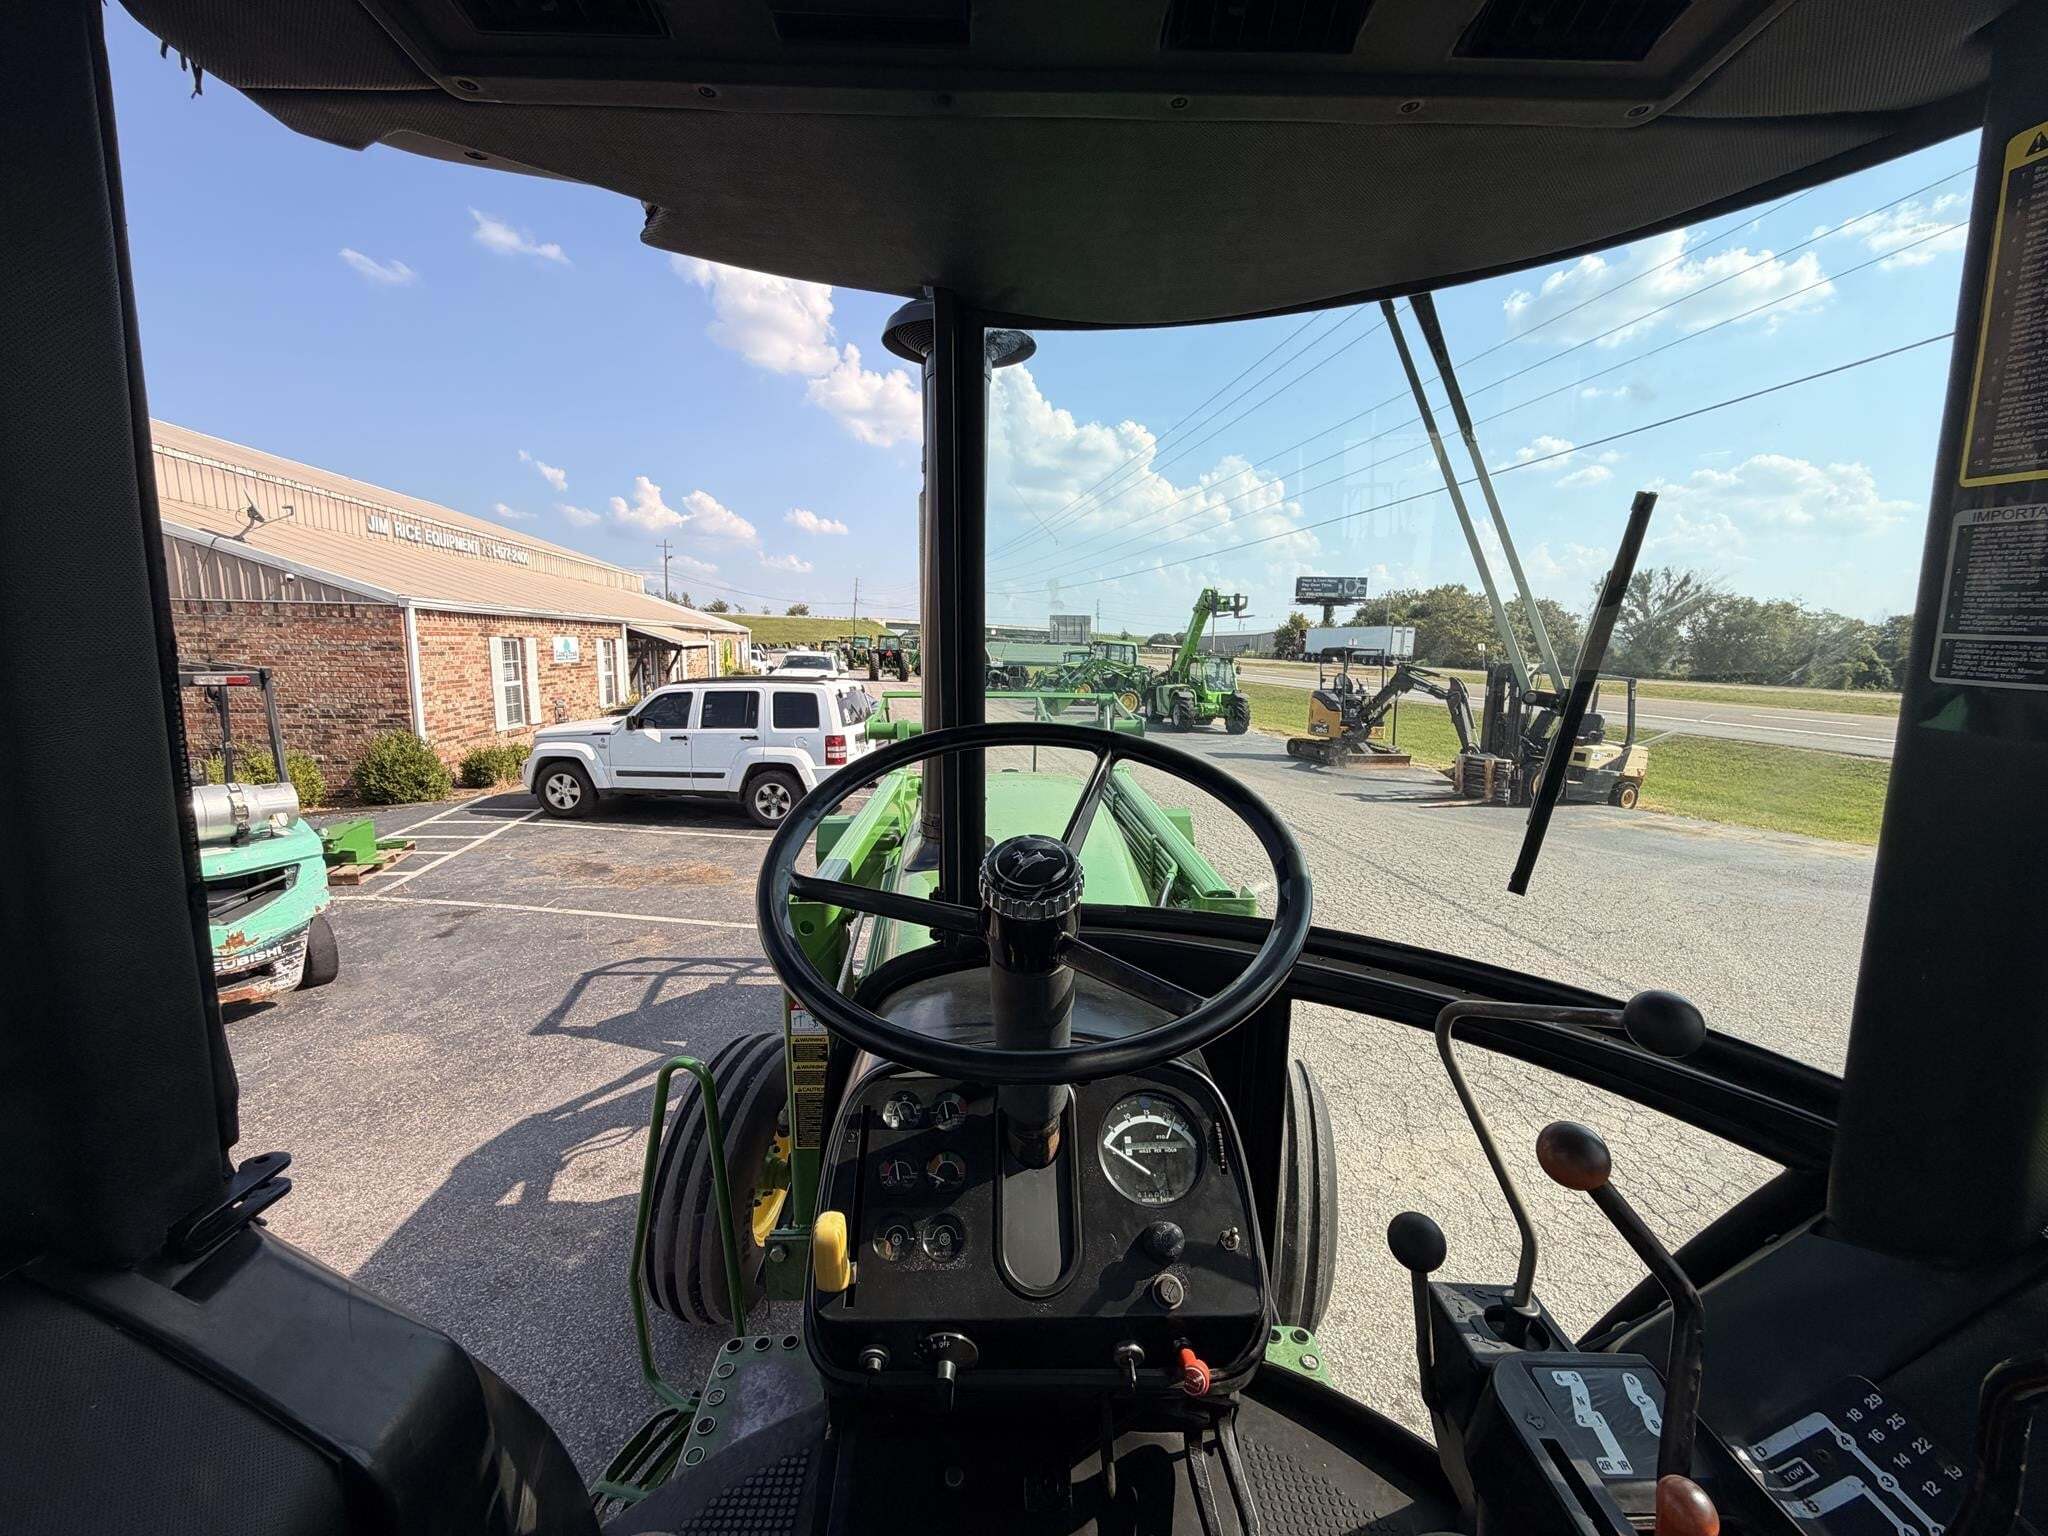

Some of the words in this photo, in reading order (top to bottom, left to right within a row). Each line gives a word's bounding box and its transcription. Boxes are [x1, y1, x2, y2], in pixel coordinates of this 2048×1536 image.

[1973, 507, 2048, 522] IMPORTA
[368, 515, 388, 535] JIM
[394, 521, 422, 541] RICE
[425, 529, 480, 555] EQUIPMENT
[1571, 1373, 1579, 1382] 3
[1627, 1376, 1635, 1385] D
[1576, 1395, 1586, 1406] N
[1636, 1395, 1646, 1405] C
[1864, 1393, 1883, 1410] 29
[1578, 1414, 1586, 1424] 2
[1846, 1408, 1863, 1423] 18
[1886, 1412, 1906, 1430] 25
[1868, 1428, 1885, 1444] 16
[1755, 1446, 1767, 1458] D
[1911, 1436, 1933, 1455] 22
[1600, 1460, 1613, 1470] 2R
[1617, 1460, 1631, 1470] 1R
[1892, 1452, 1912, 1469] 14
[1944, 1465, 1964, 1480] 19
[1881, 1476, 1894, 1488] 3
[1922, 1480, 1942, 1497] 12
